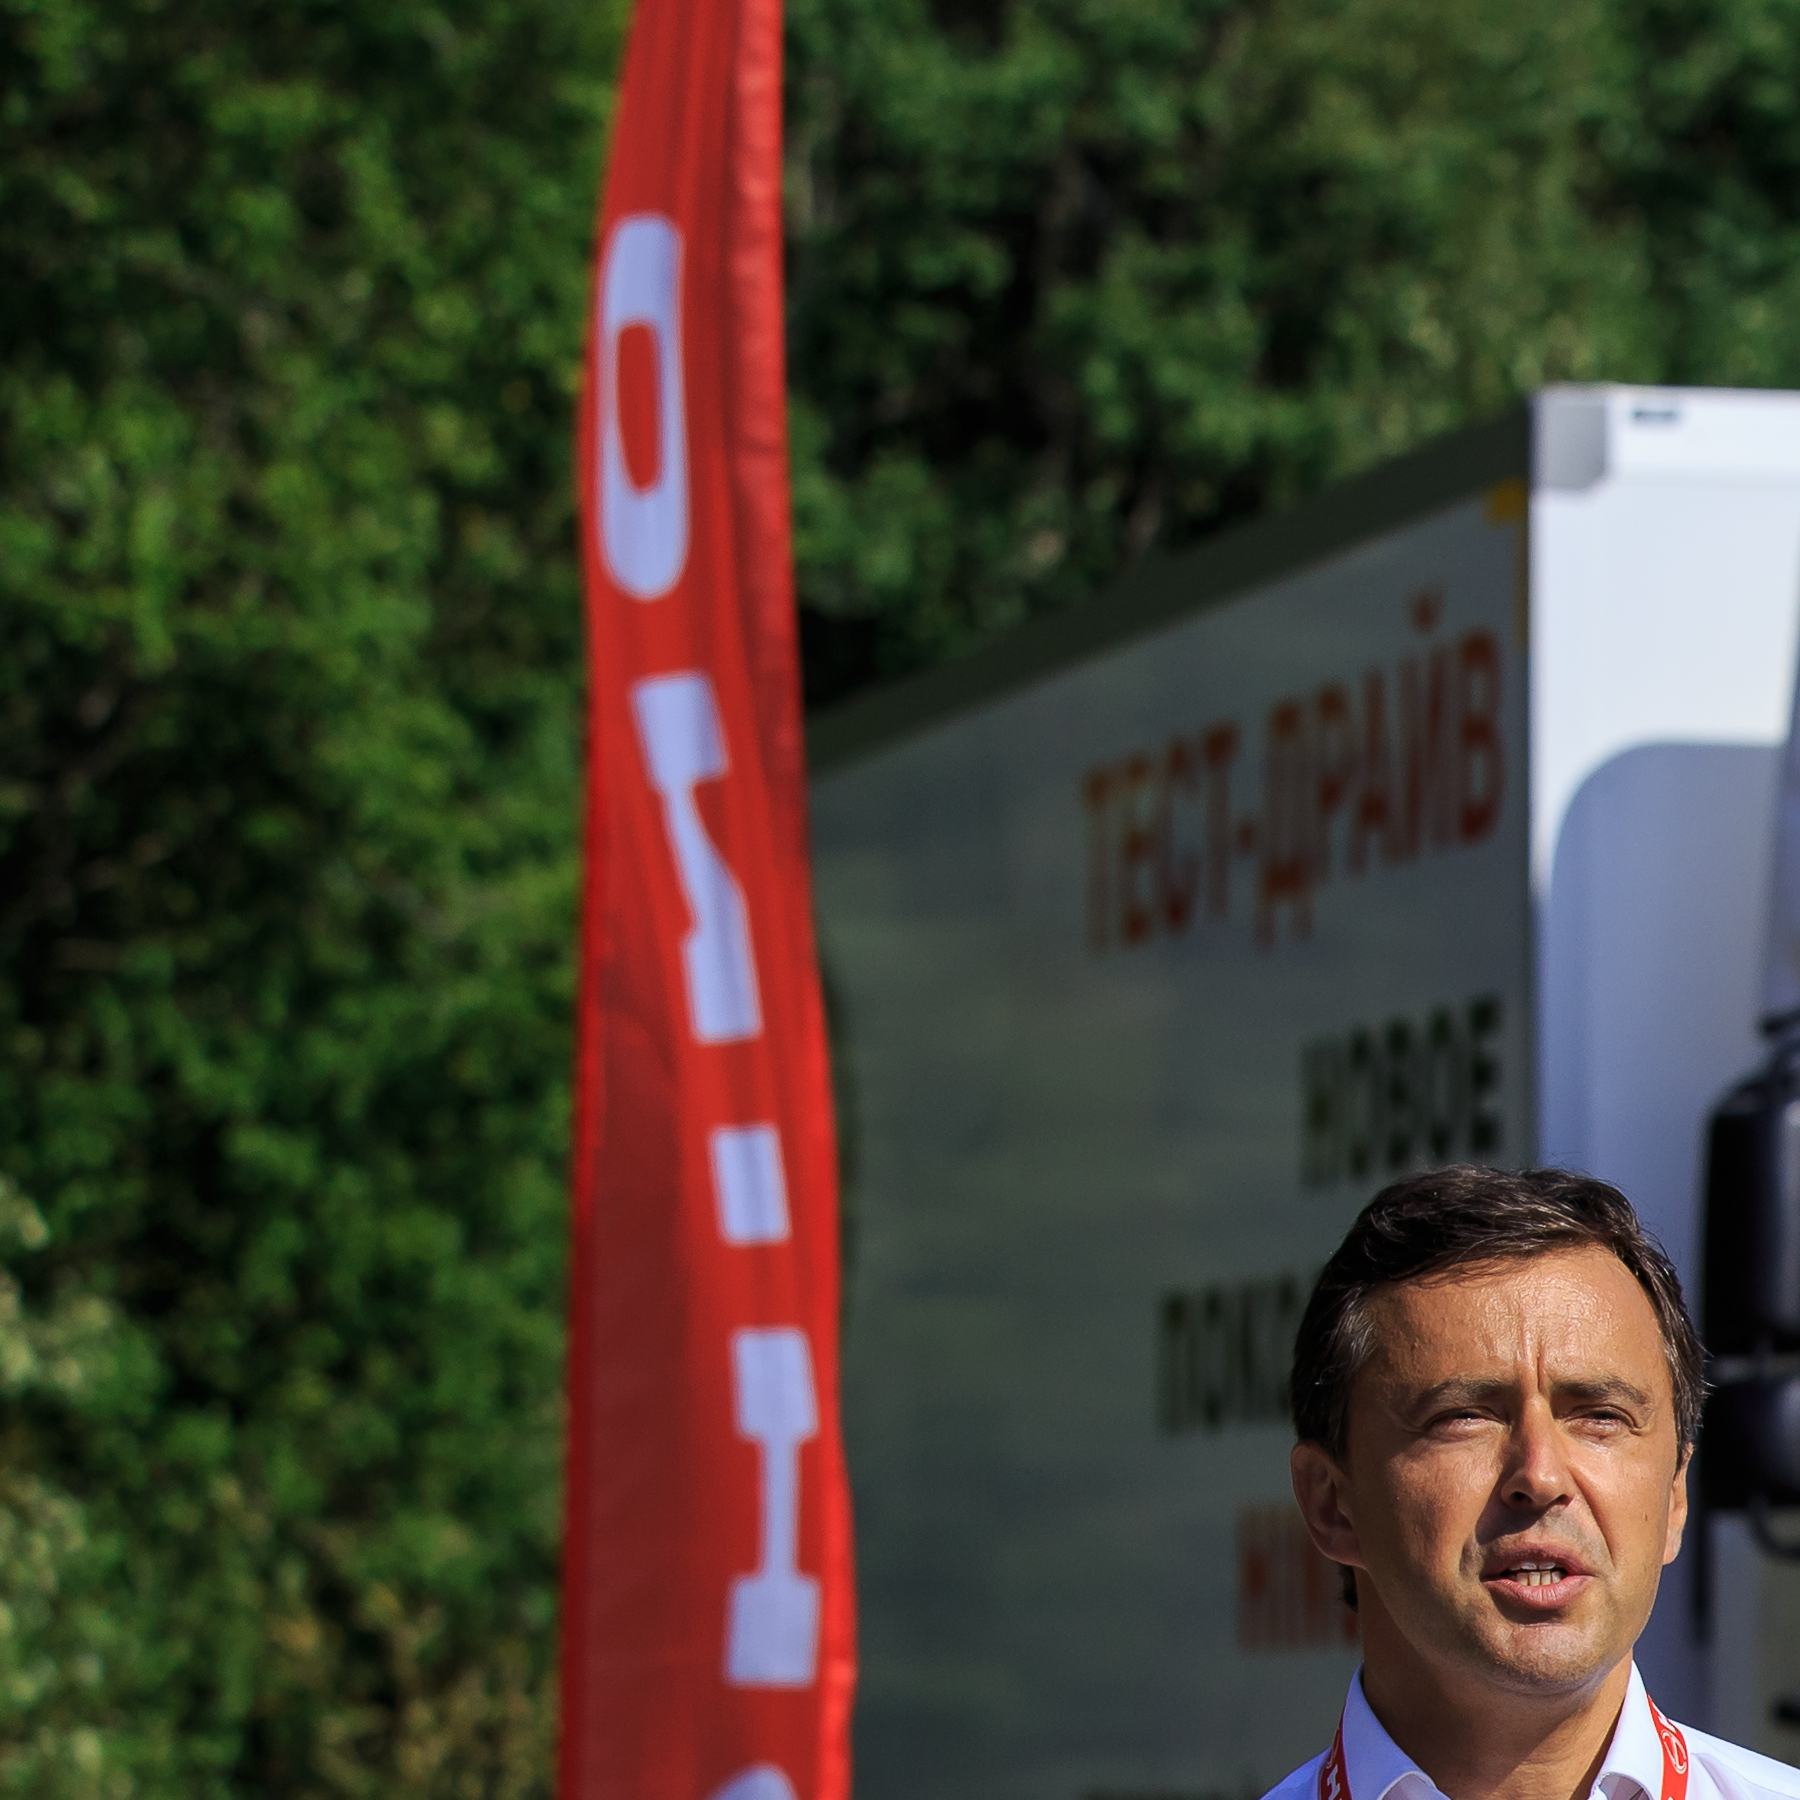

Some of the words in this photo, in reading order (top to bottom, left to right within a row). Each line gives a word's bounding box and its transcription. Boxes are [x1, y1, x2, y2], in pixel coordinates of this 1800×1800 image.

[602, 212, 818, 1685] HINO
[1083, 588, 1503, 955] ТЕСТ-ДРАЙВ
[1302, 997, 1502, 1190] НОВОЕ
